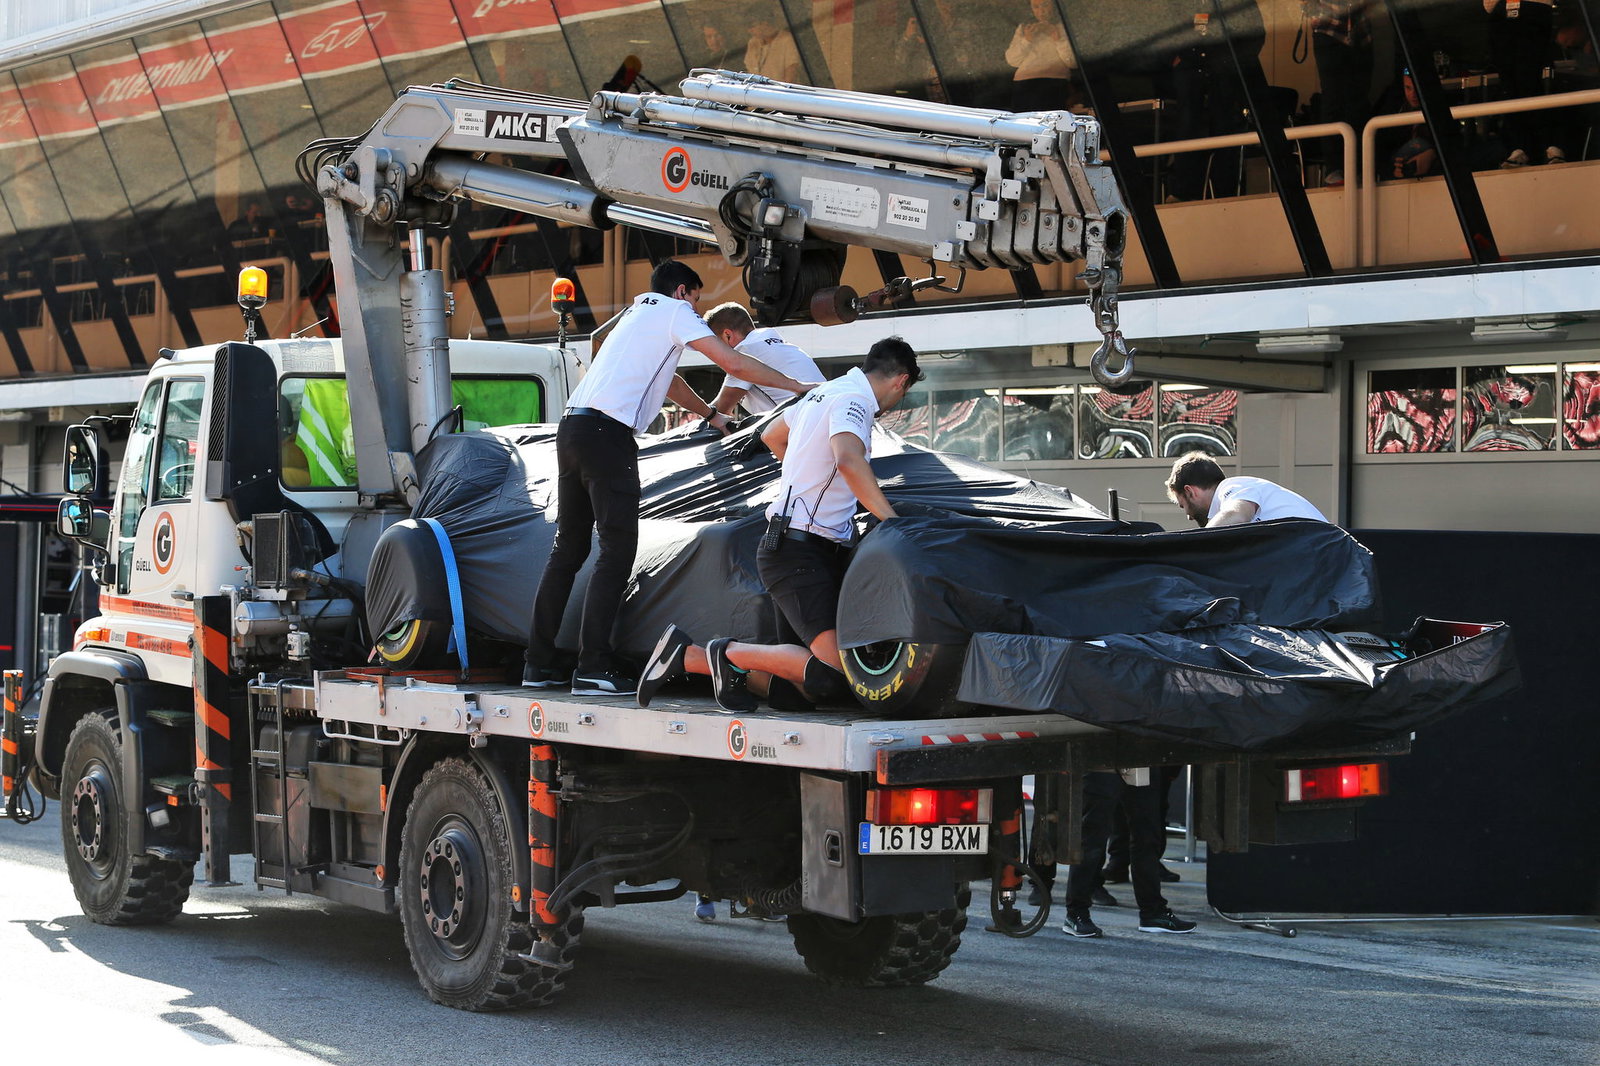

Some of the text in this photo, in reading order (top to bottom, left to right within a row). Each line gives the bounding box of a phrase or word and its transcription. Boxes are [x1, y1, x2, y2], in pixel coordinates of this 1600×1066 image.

[488, 112, 542, 138] MKG
[690, 169, 729, 190] GÜELL
[135, 558, 152, 572] GÜELL
[1343, 635, 1381, 645] PETRONAS
[855, 670, 904, 701] ZERO
[750, 743, 777, 759] GÜELL
[941, 826, 981, 850] BXM
